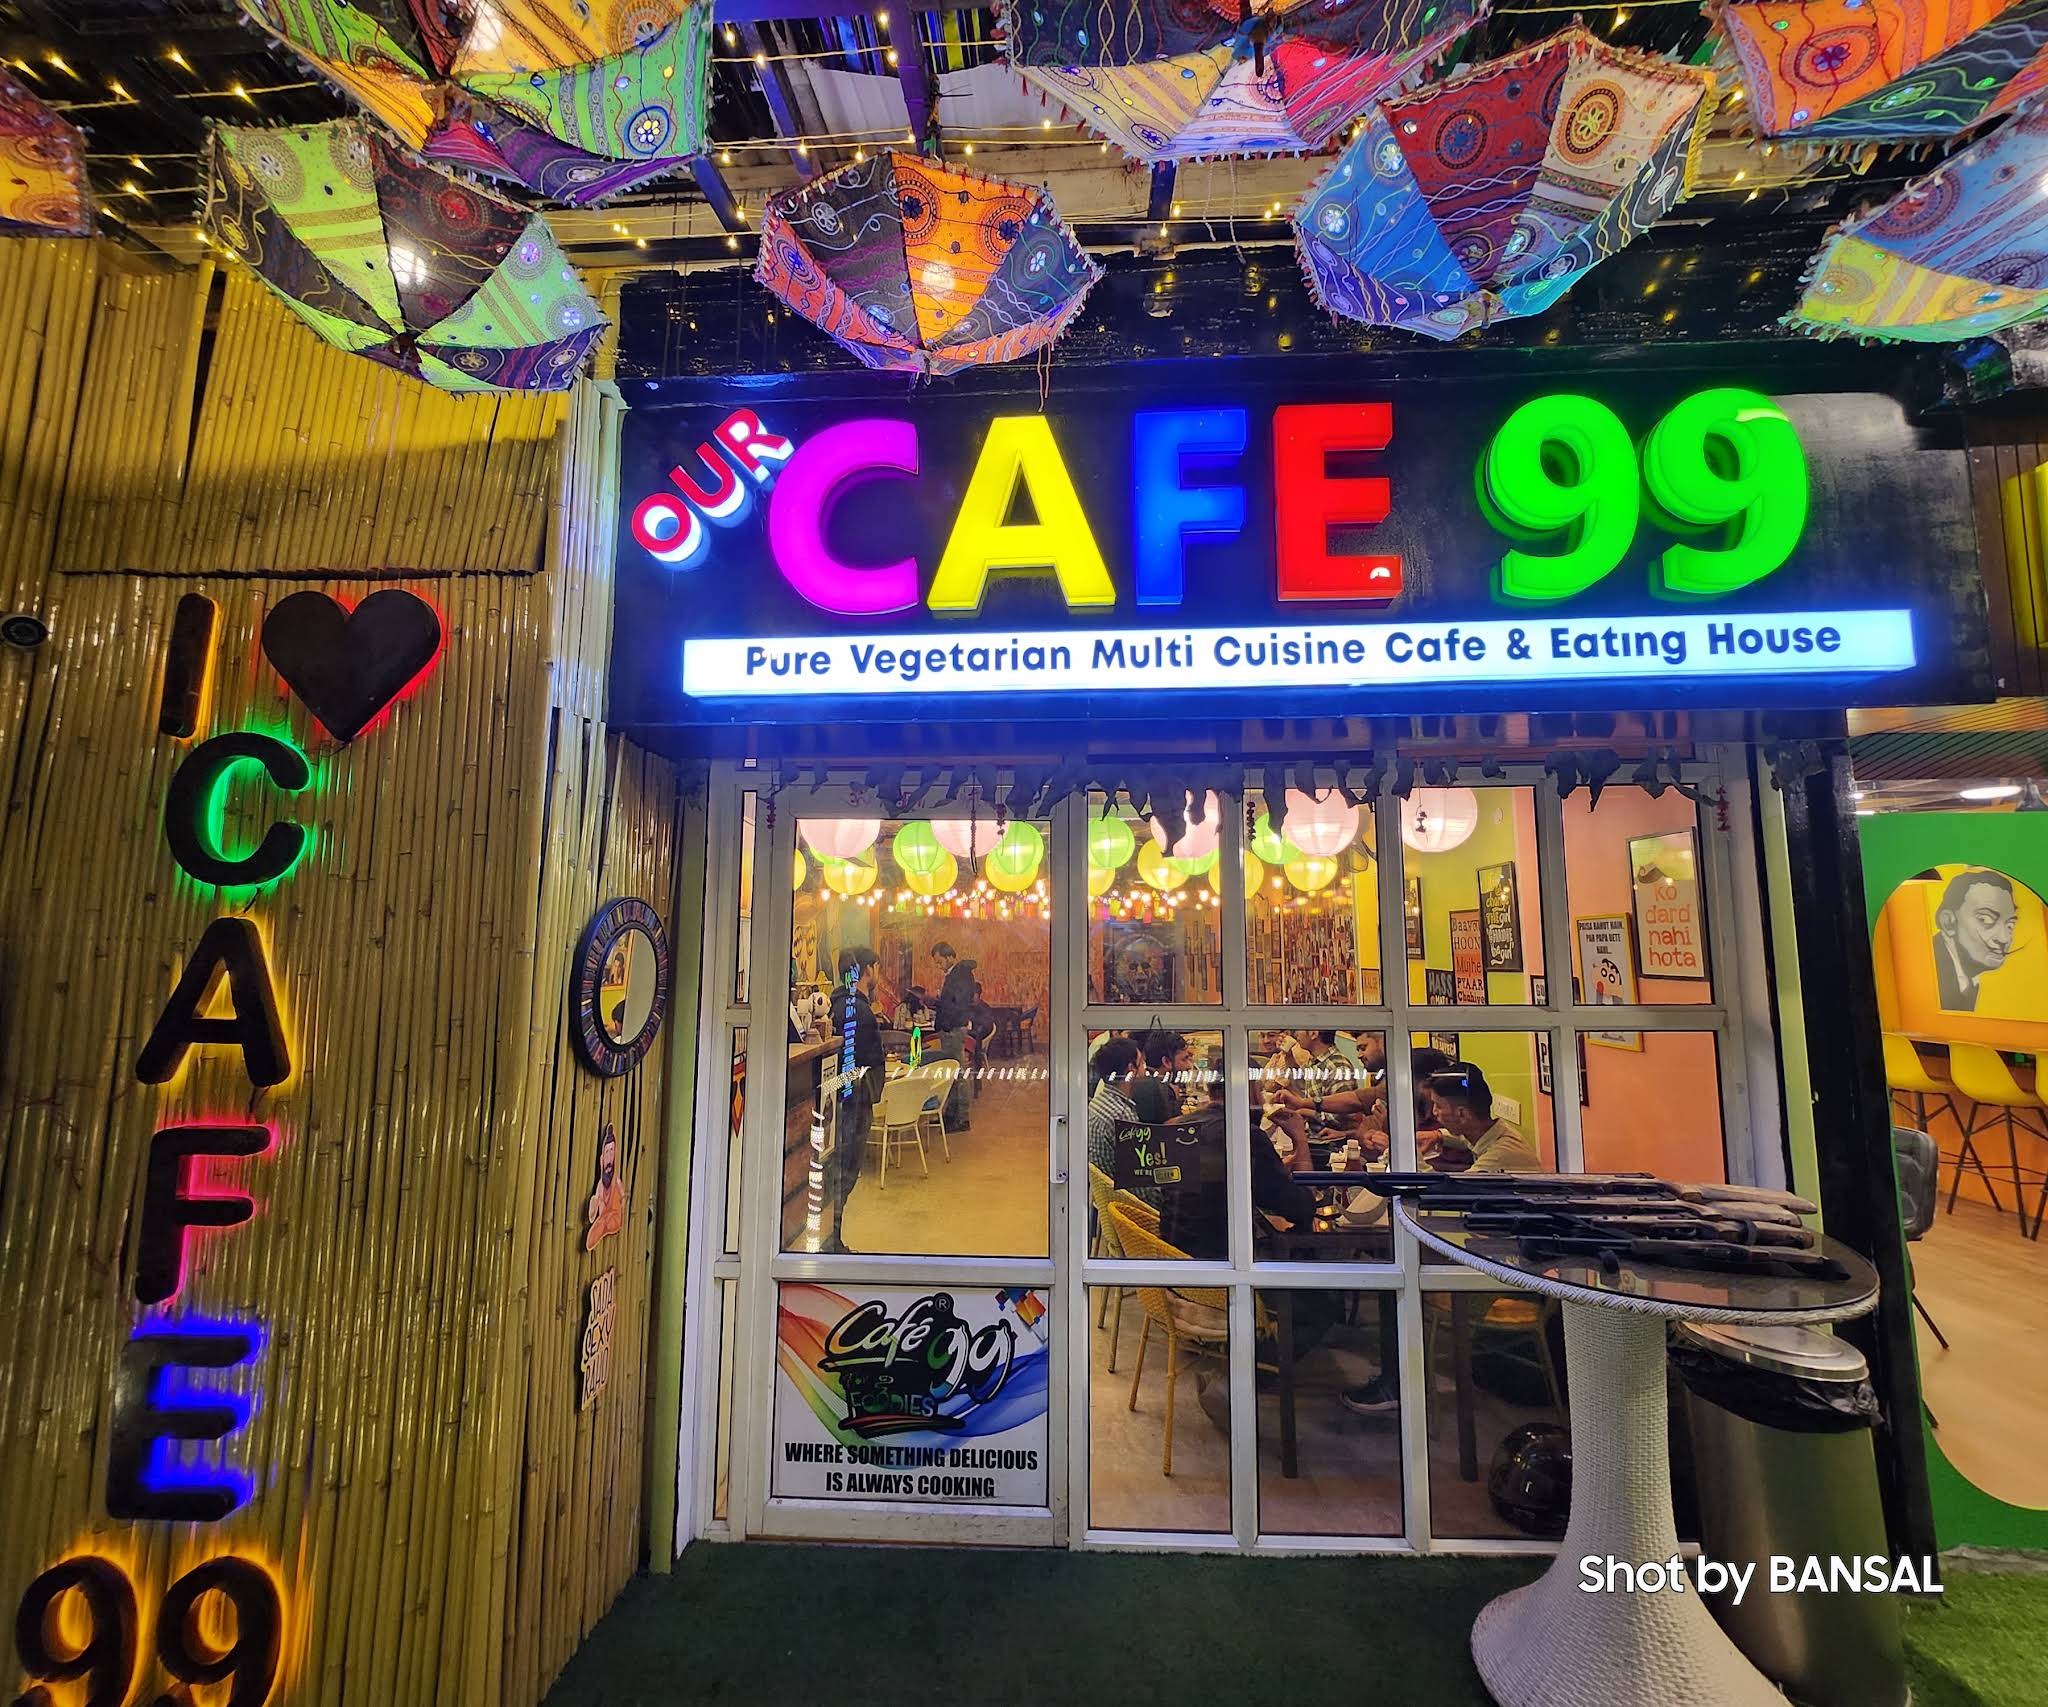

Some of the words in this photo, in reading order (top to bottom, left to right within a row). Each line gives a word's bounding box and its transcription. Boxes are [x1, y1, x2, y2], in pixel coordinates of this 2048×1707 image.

[631, 408, 794, 562] OUR
[769, 402, 1403, 614] CAFE
[1478, 387, 1810, 602] 99
[160, 592, 219, 738] I
[746, 645, 831, 676] Pure
[850, 638, 1071, 682] Vegetarian
[1092, 635, 1194, 668] Multi
[1213, 632, 1366, 667] Cuisine
[1384, 628, 1487, 662] Cafe
[1507, 628, 1533, 660] &
[1552, 625, 1688, 665] Eating
[1708, 623, 1842, 656] House
[1645, 904, 1691, 924] dard
[1648, 926, 1692, 946] nahi
[1648, 947, 1697, 968] hota
[1457, 977, 1484, 991] PYAAR
[106, 731, 312, 1520] CAFE
[1134, 1141, 1168, 1168] Yes!
[829, 1300, 934, 1368] Café
[785, 1442, 843, 1463] WHERE
[847, 1444, 945, 1467] SOMETHING
[950, 1449, 1038, 1470] DELICIOUS
[825, 1472, 839, 1492] IS
[846, 1473, 914, 1495] ALWAYS
[917, 1475, 995, 1497] COOKING
[15, 1555, 283, 1707] 99
